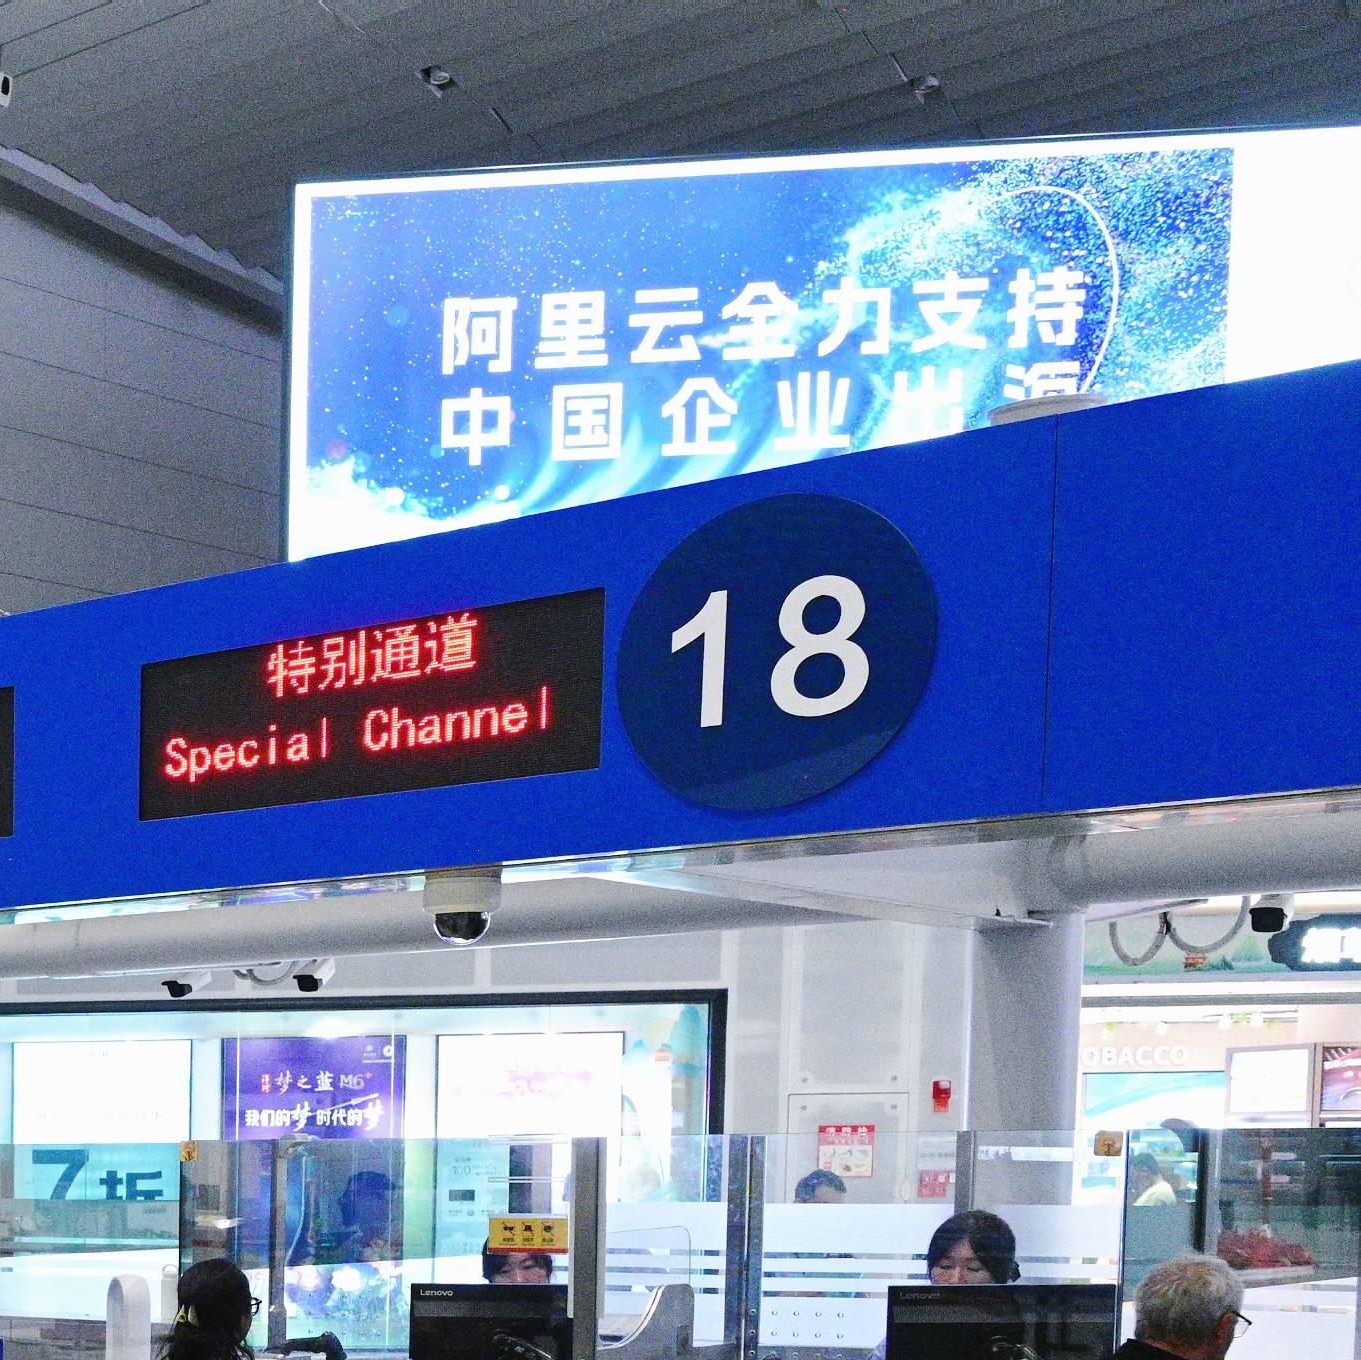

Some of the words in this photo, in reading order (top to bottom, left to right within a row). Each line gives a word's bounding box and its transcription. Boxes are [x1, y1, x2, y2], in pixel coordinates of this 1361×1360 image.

[442, 267, 1087, 375] 阿里云全力支持
[266, 613, 479, 698] 特别通道
[672, 574, 870, 729] 18
[164, 730, 329, 783] Special
[363, 686, 551, 754] Channel
[275, 1069, 335, 1095] 梦之蓝
[245, 1101, 311, 1132] 我们的梦
[316, 1099, 384, 1132] 时代的梦
[420, 1289, 454, 1297] Lenovo
[900, 1291, 940, 1299] Lenovo
